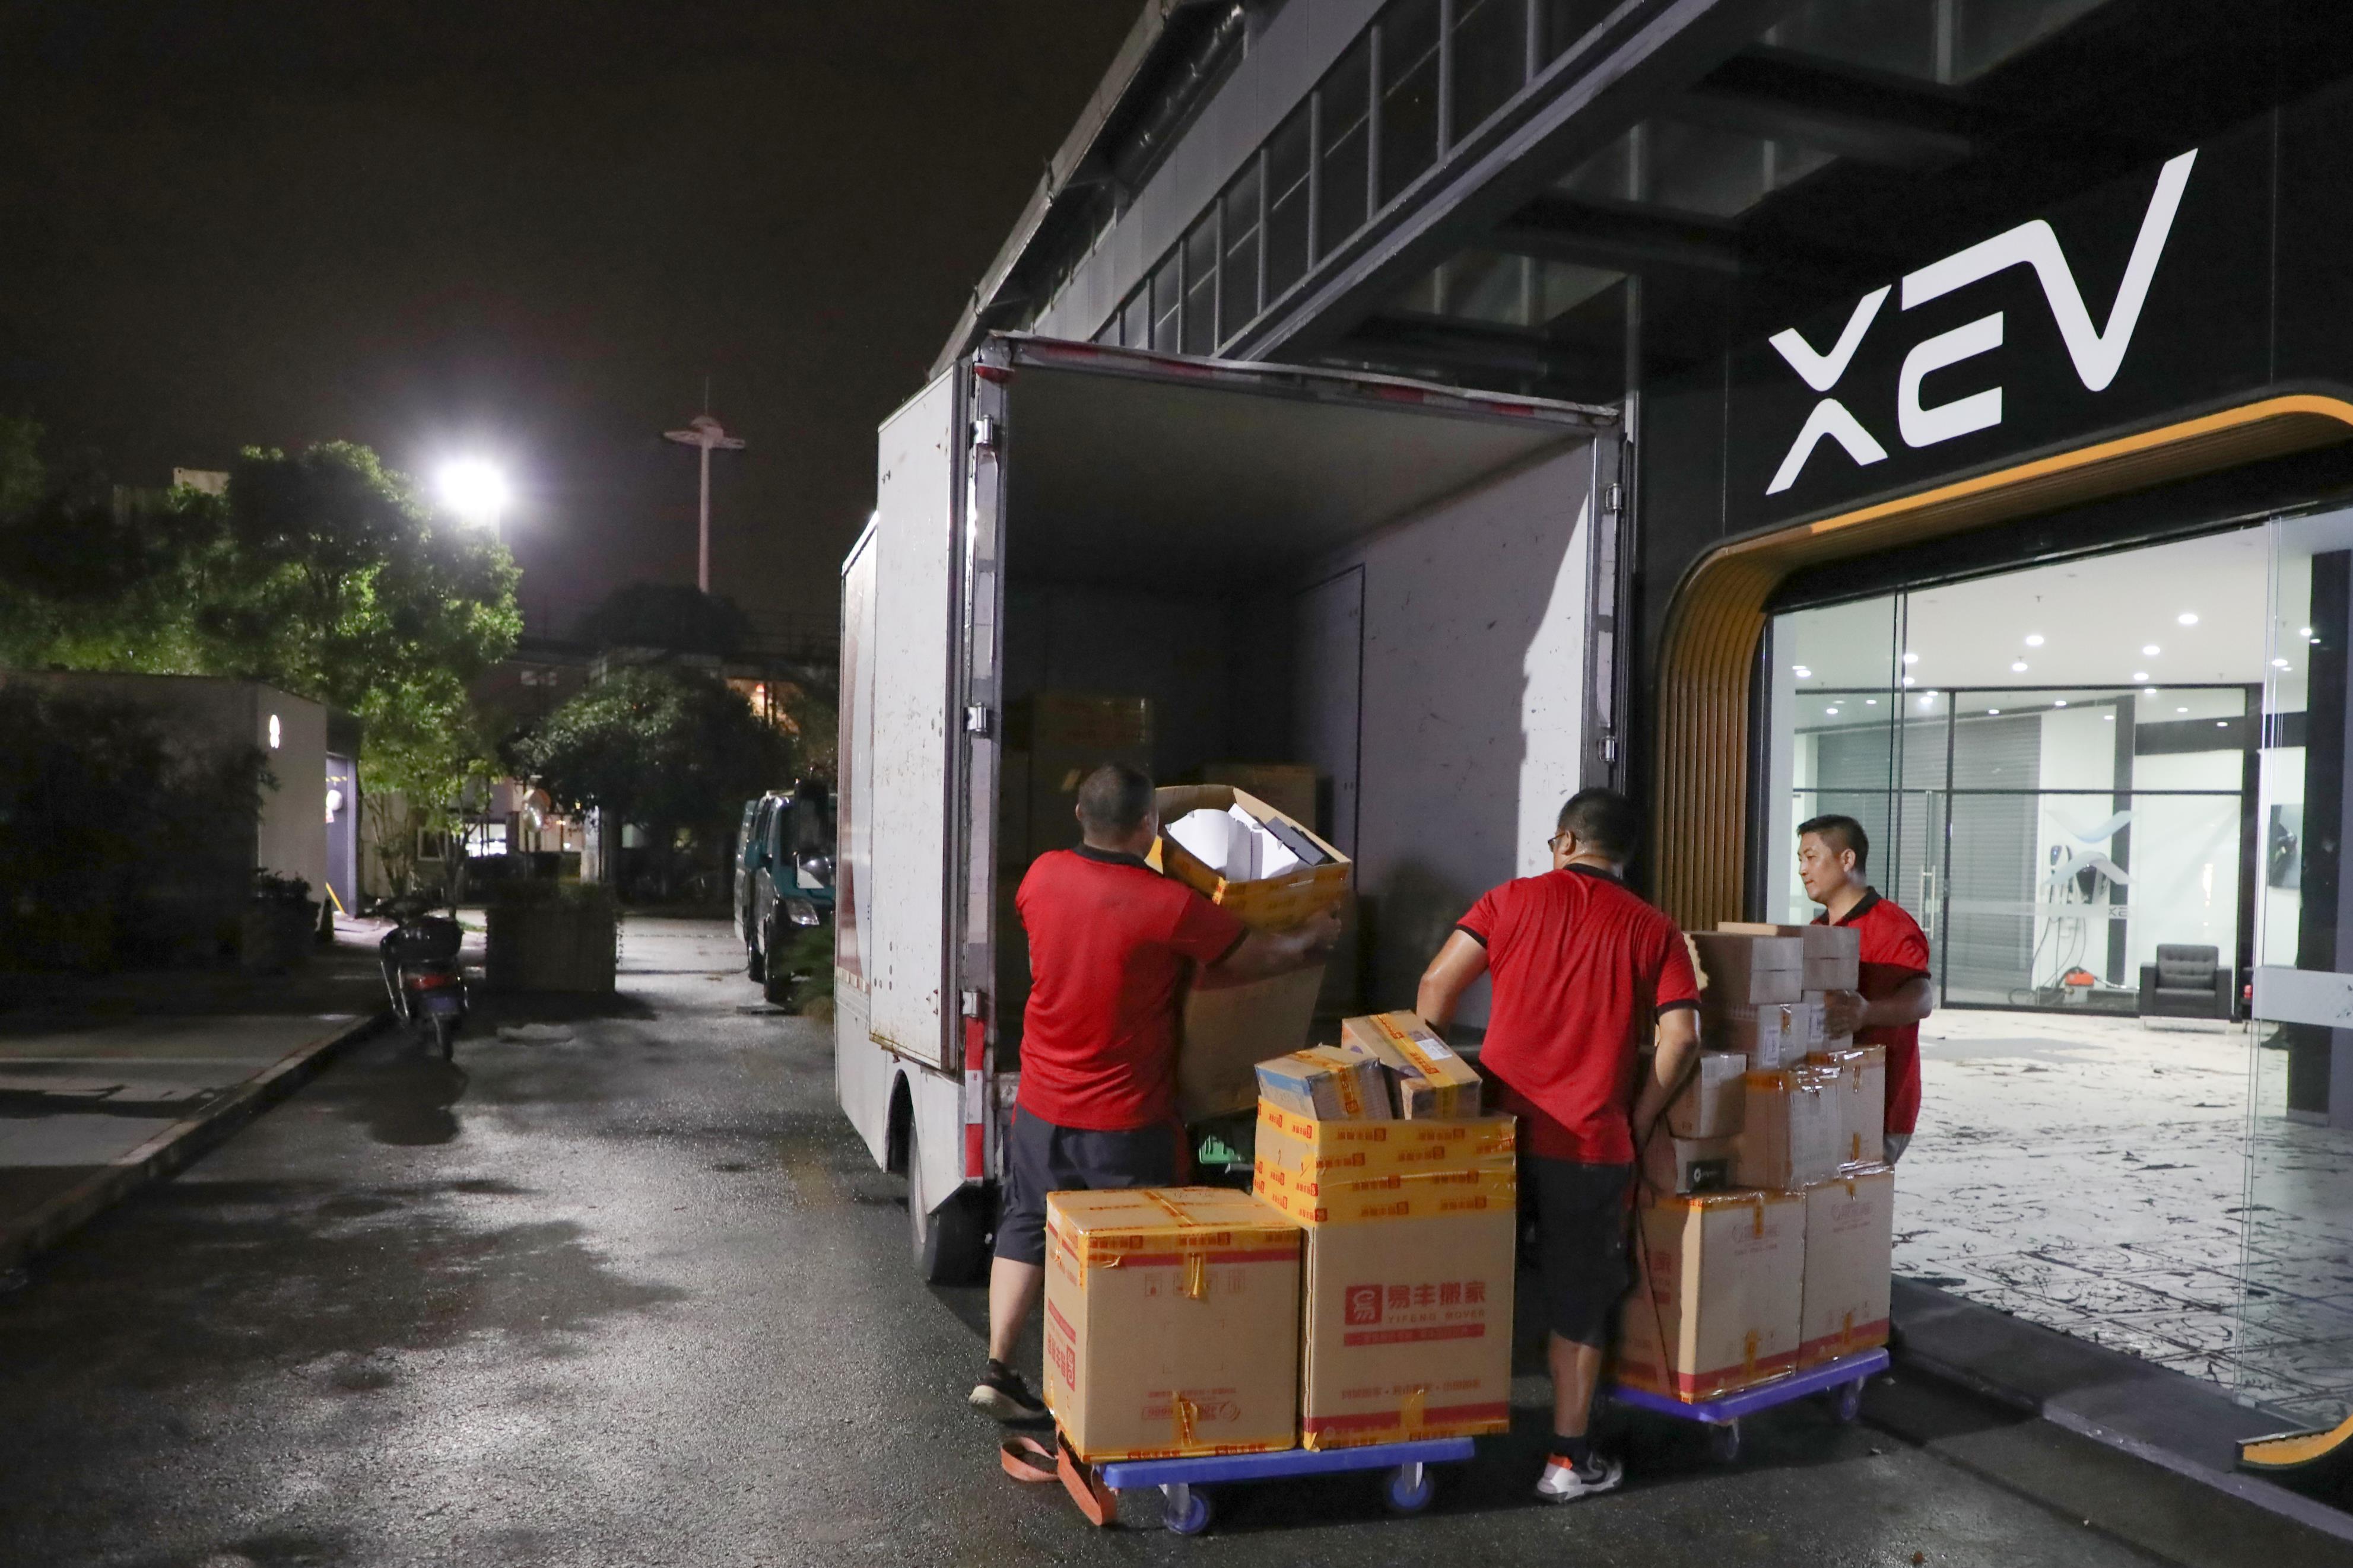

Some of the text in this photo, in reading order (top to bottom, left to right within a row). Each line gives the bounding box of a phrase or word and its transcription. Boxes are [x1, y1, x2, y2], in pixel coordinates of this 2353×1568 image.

[1765, 148, 2198, 495] XEV
[1388, 1310, 1485, 1323] YIFENG MOVER
